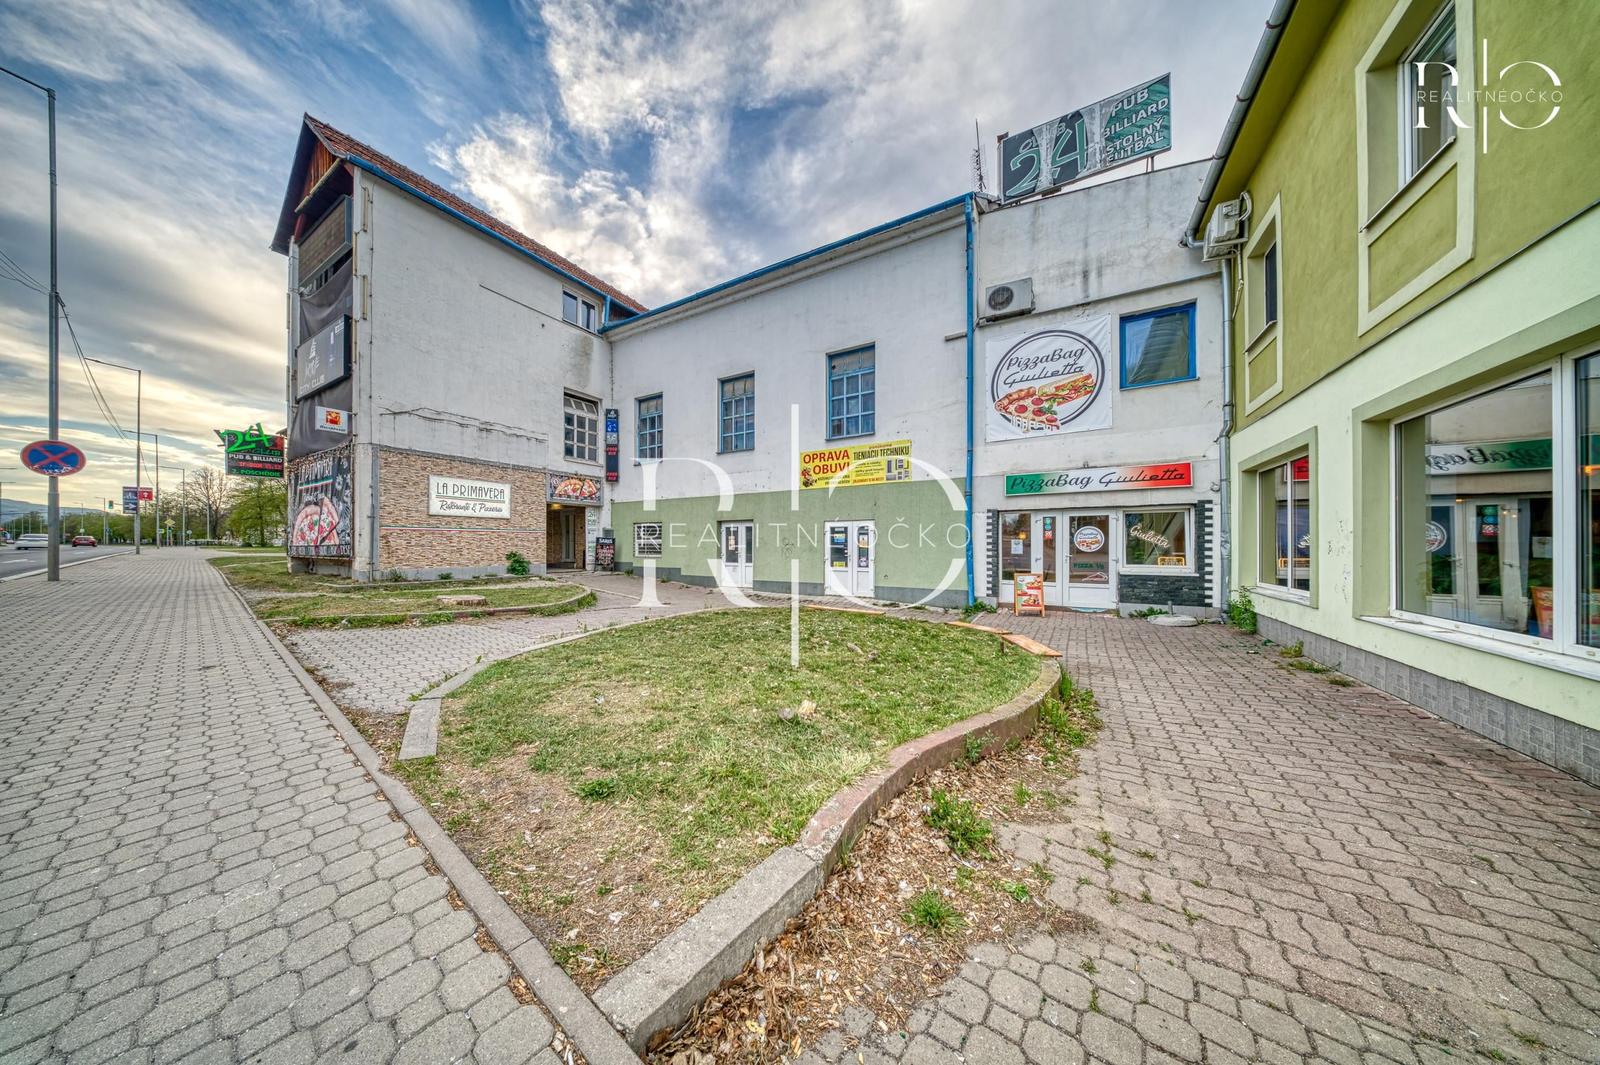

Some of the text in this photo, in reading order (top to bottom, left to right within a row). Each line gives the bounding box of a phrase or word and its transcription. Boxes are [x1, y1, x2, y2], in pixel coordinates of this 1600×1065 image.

[1111, 88, 1149, 117] PUB
[1103, 97, 1169, 138] BILLIARD
[1106, 115, 1164, 155] STOLNÝ
[1006, 118, 1086, 197] 24
[1006, 347, 1087, 372] PizzaBag
[1003, 362, 1085, 388] Giulietta
[219, 422, 272, 453] 24
[803, 449, 850, 464] OPRAVA
[880, 445, 910, 457] TECHNIKU
[812, 461, 850, 475] OBUVI
[1010, 468, 1185, 492] PizzaBag Giulietta
[436, 482, 505, 500] LA PRIMAVERA
[471, 503, 477, 513] &
[1130, 523, 1170, 548] Giulietta
